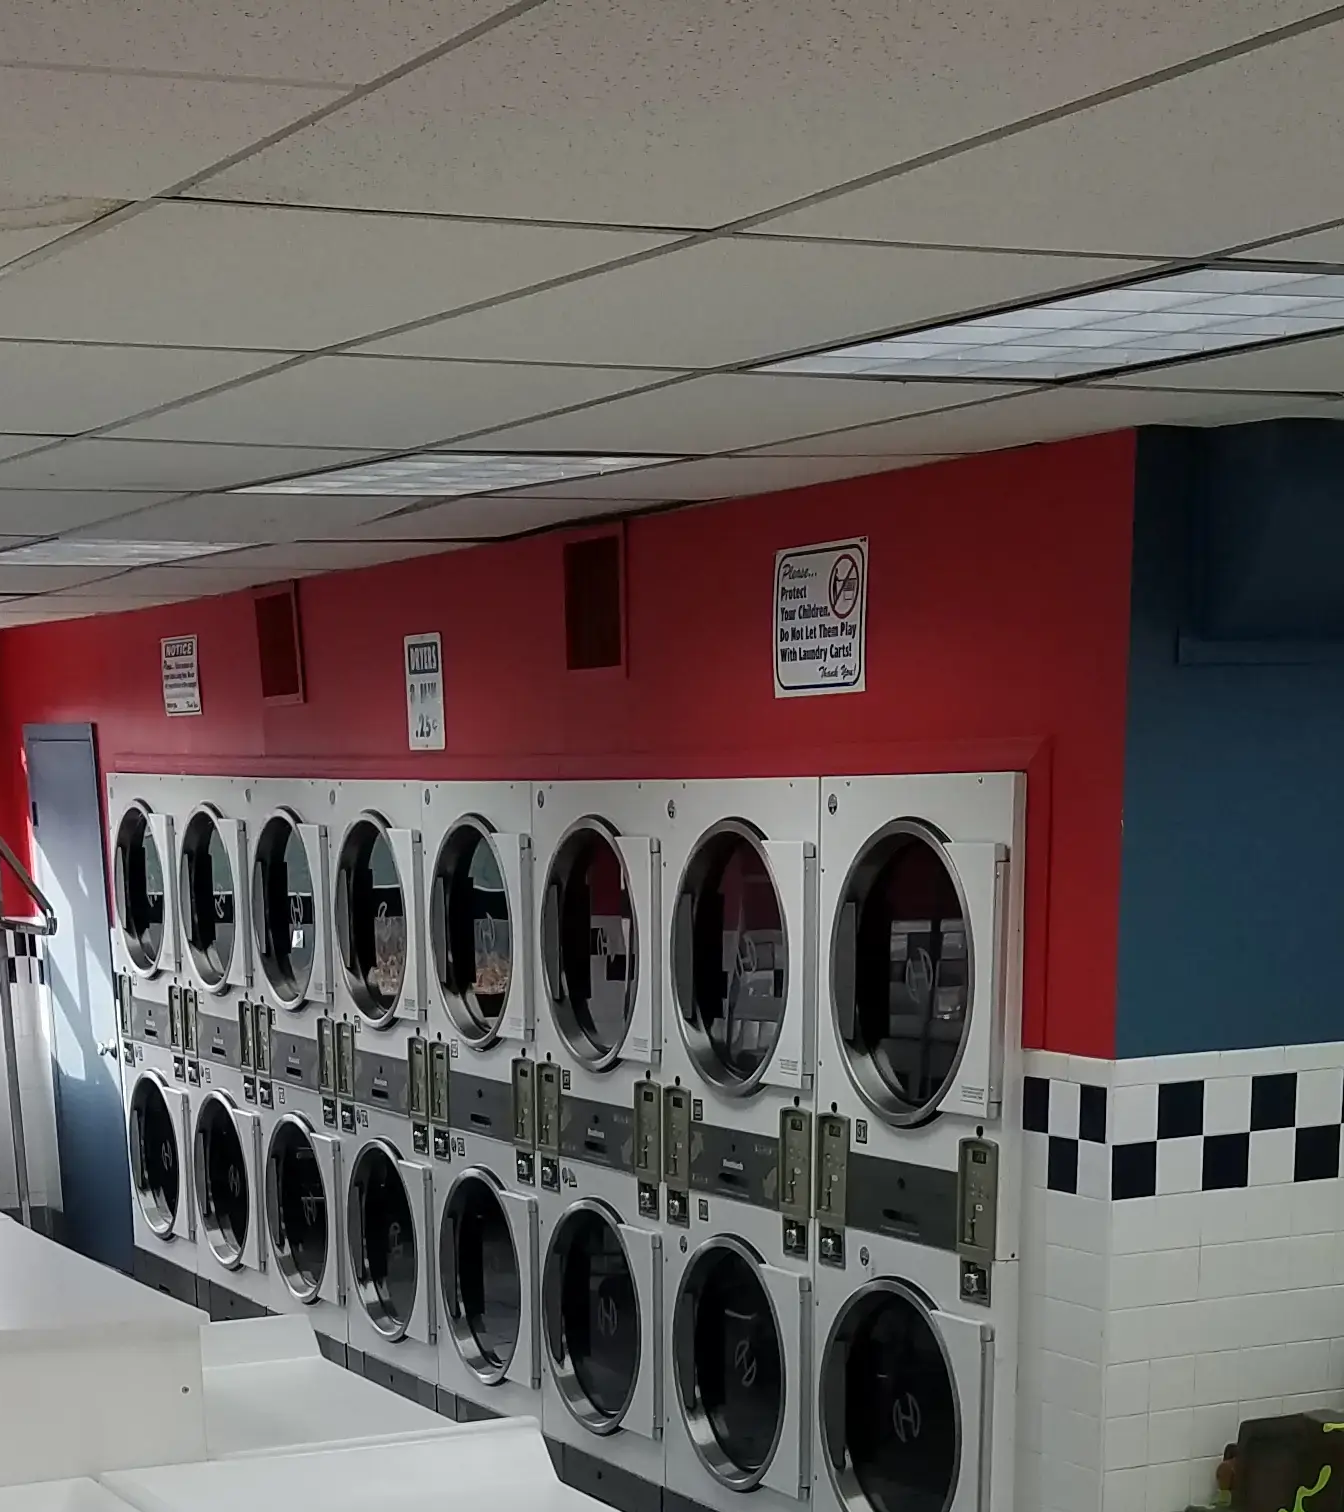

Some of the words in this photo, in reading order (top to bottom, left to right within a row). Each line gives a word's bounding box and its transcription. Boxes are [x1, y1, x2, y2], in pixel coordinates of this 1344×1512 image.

[781, 586, 807, 602] Protect
[780, 607, 796, 622] Your
[779, 627, 789, 643] Do
[790, 626, 804, 642] Not
[805, 625, 817, 640] Let
[818, 623, 839, 639] Them
[840, 621, 857, 639] Play
[165, 642, 193, 656] NOTICE
[410, 645, 436, 670] DRYERS
[780, 647, 797, 662] With
[798, 645, 827, 662] Laundry
[829, 642, 852, 659] Carts!
